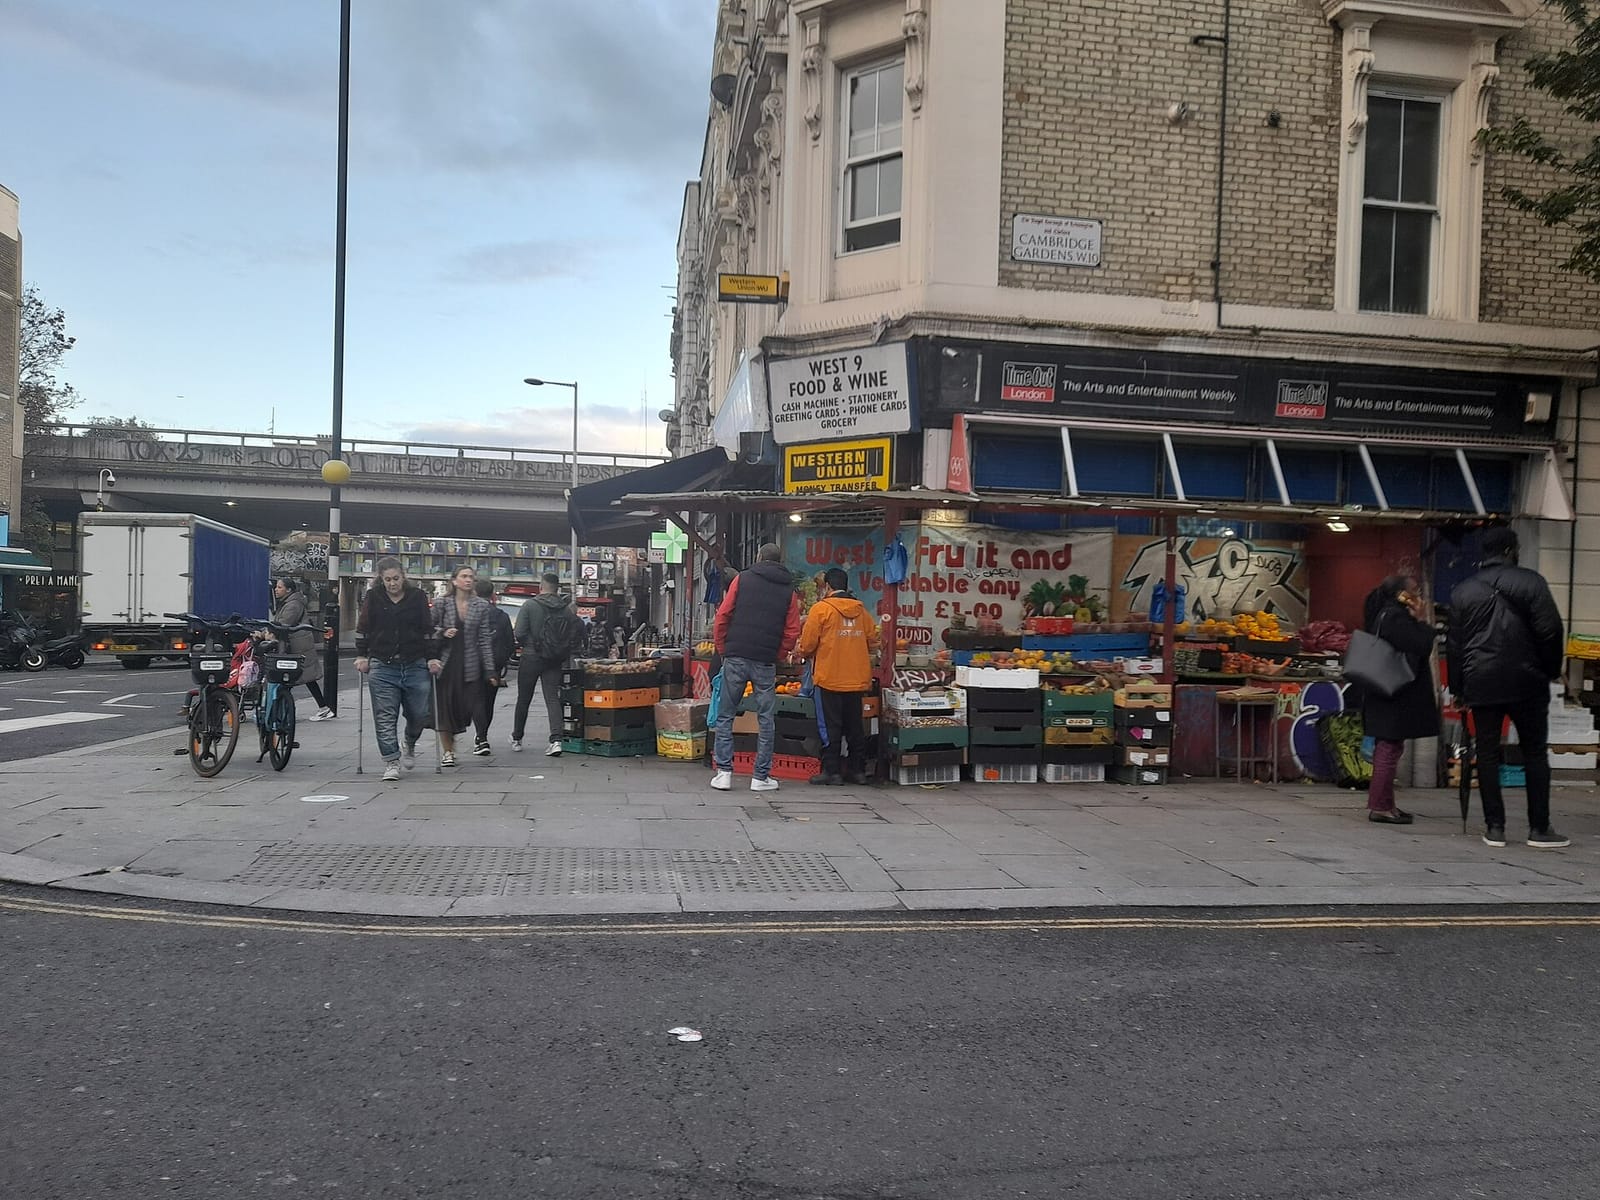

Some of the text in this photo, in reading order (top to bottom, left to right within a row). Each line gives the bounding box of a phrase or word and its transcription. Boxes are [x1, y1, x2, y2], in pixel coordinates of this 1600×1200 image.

[1019, 233, 1094, 251] CAMBRIDGE
[728, 277, 756, 285] Western
[808, 355, 863, 377] WEST 9
[789, 370, 889, 398] FOOD & WINE
[1006, 364, 1055, 388] Time Out
[1010, 388, 1046, 400] London
[1062, 380, 1081, 392] The
[1083, 381, 1103, 393] Arts
[1106, 383, 1125, 395] and
[1127, 384, 1198, 399] Entertainment
[781, 390, 899, 412] CASH MACHINE STATIONERY
[1334, 396, 1353, 408] The
[1354, 397, 1373, 409] Arts
[1375, 399, 1393, 411] and
[1394, 400, 1460, 414] Entertainment
[774, 400, 907, 424] GREETING CARDS PHONE CARDS
[1284, 405, 1317, 417] London
[820, 416, 858, 429] GROCERY
[793, 450, 866, 468] WESTERN
[816, 463, 866, 479] UNION
[829, 481, 878, 492] TRANSFER
[805, 537, 876, 565] West
[1011, 543, 1073, 570] and
[48, 575, 54, 586] A
[859, 571, 969, 596] Veetable
[978, 577, 1020, 600] any
[896, 628, 933, 644] OUND
